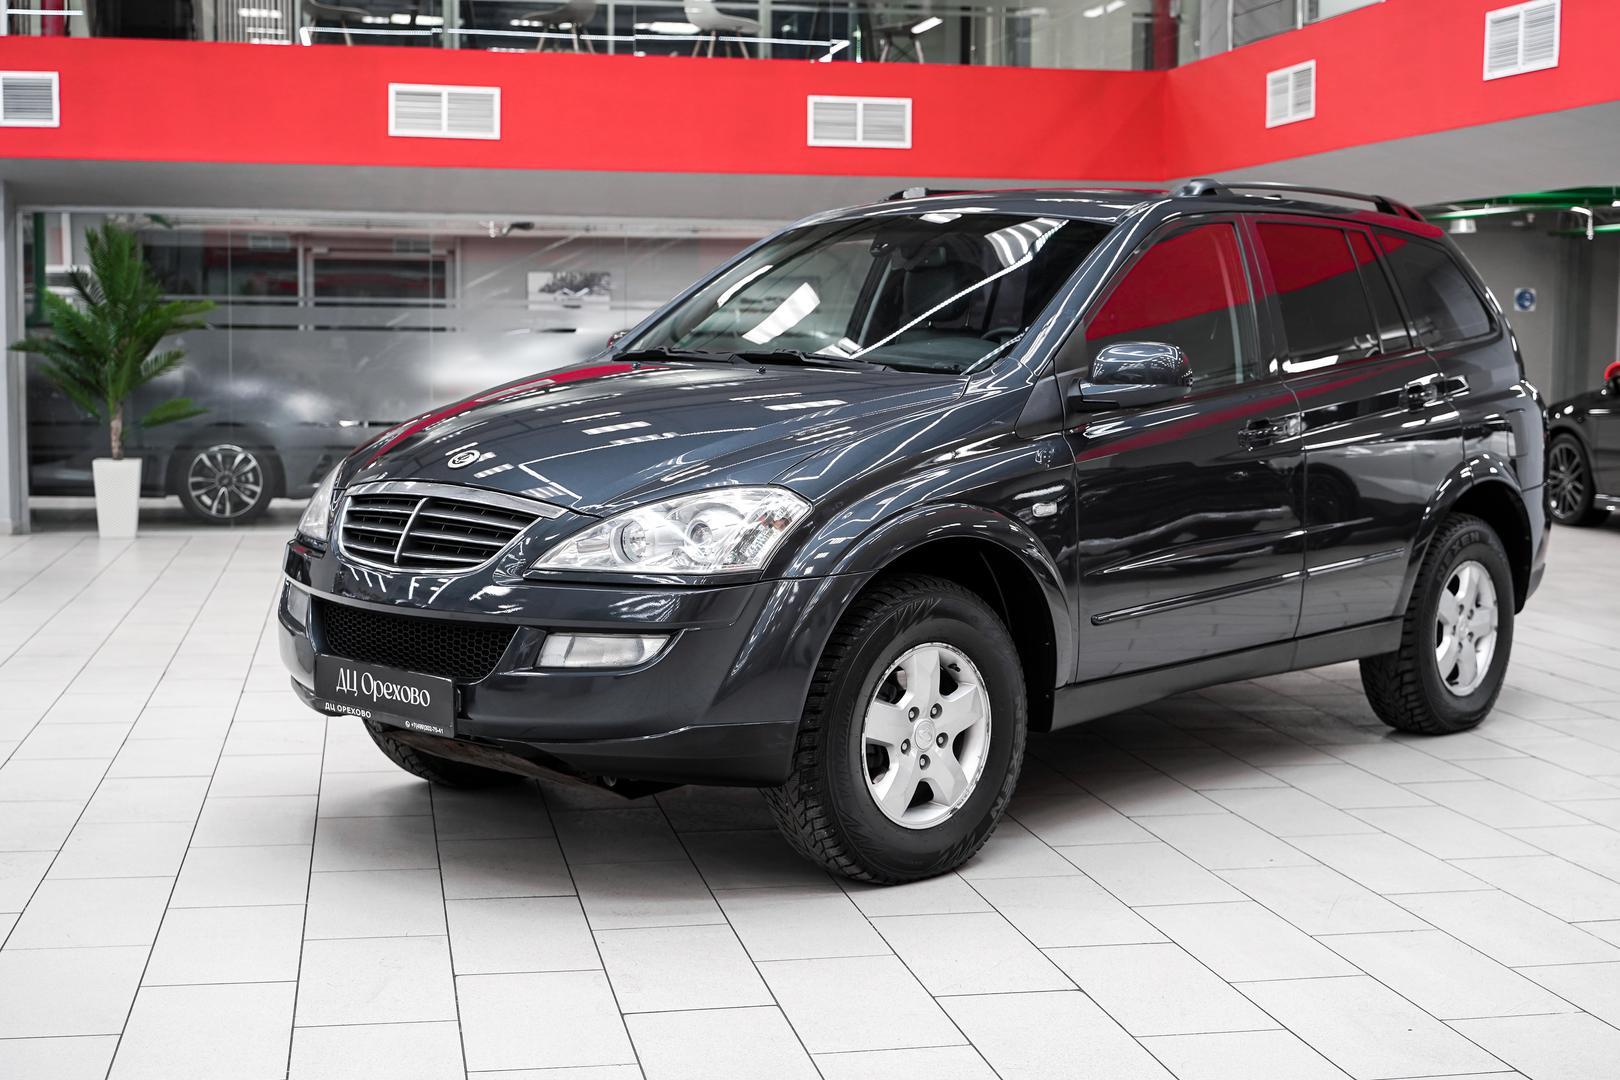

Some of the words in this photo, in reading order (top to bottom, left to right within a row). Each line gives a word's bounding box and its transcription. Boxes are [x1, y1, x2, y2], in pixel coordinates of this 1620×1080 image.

[336, 668, 357, 696] ДЦ
[361, 672, 430, 706] Орехово
[325, 702, 336, 711] ДЦ
[336, 705, 372, 719] ОРЕХОВО
